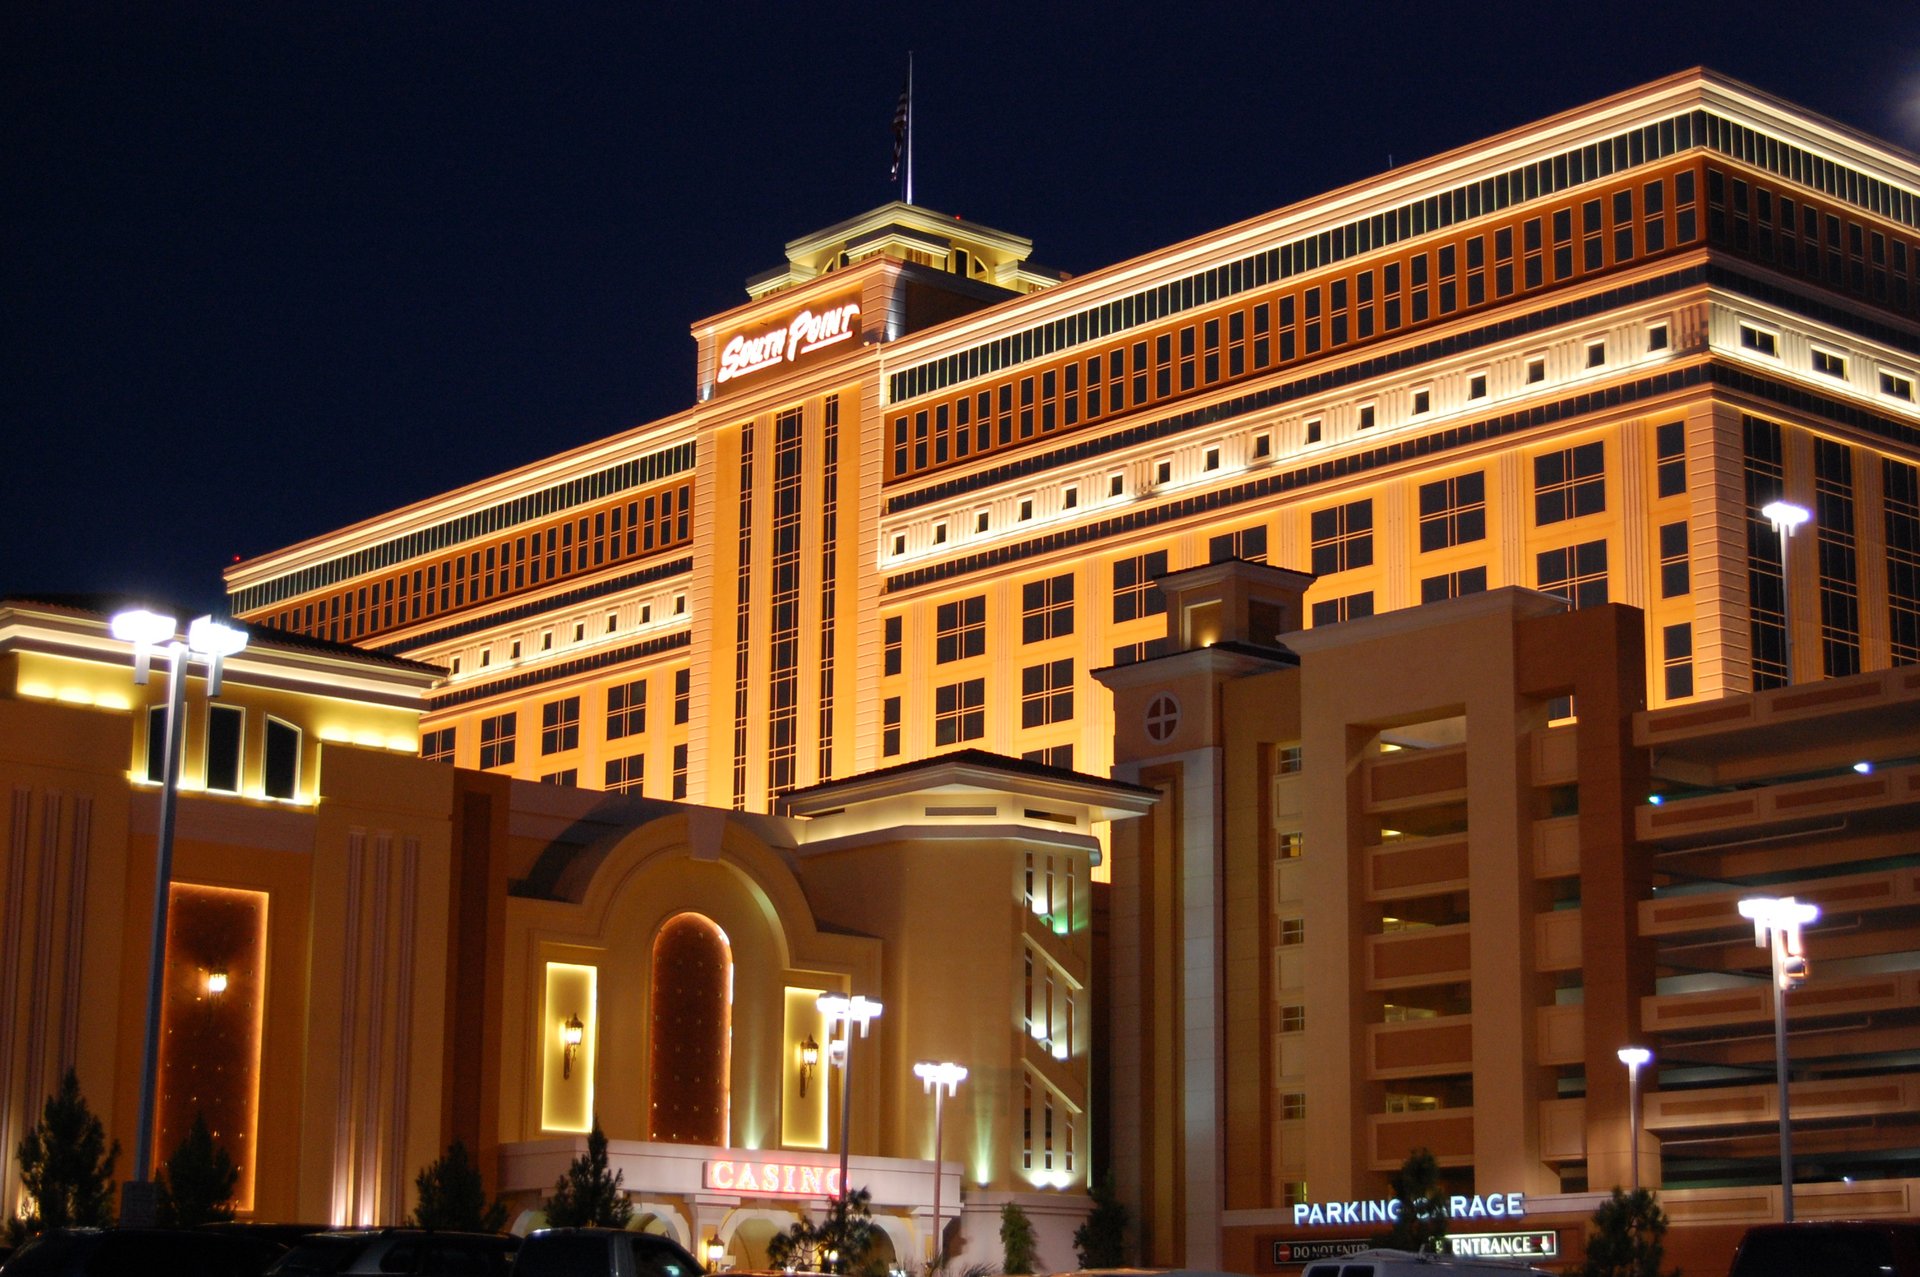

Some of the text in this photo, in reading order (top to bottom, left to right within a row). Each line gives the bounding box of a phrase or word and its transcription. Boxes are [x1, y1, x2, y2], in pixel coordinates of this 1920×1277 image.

[713, 1161, 848, 1195] CASINO
[1293, 1199, 1401, 1224] PARKING
[1293, 1246, 1310, 1258] DO
[1452, 1236, 1531, 1256] ENTRANCE
